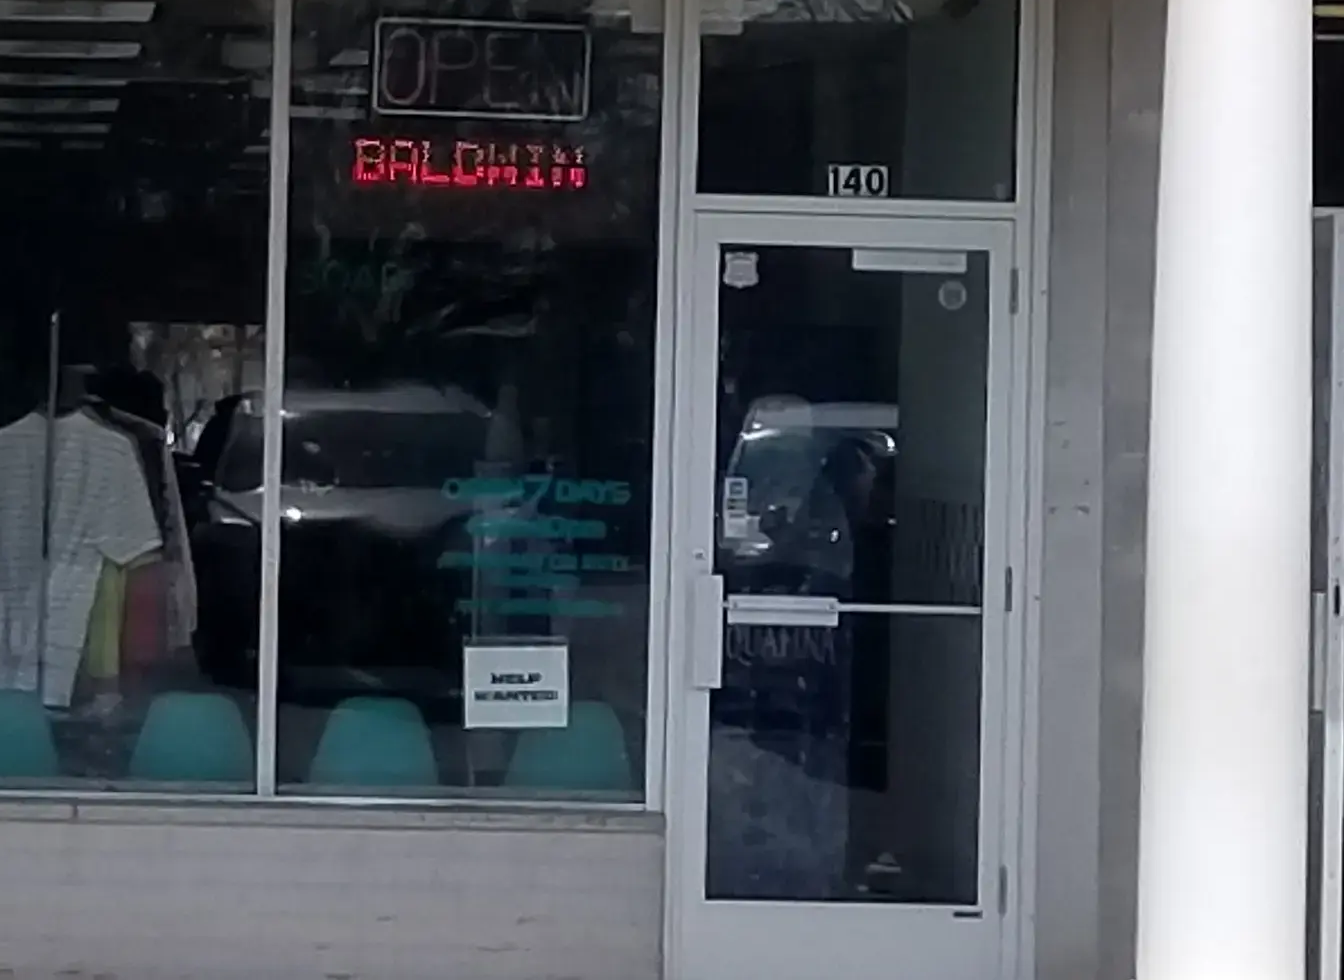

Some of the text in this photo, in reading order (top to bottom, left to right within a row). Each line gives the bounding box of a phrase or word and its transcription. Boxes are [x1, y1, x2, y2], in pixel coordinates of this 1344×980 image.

[380, 26, 580, 112] OPEN
[352, 137, 588, 188] BALDWIN
[830, 166, 885, 195] 140
[557, 478, 632, 506] DAYS
[489, 672, 543, 685] HELP
